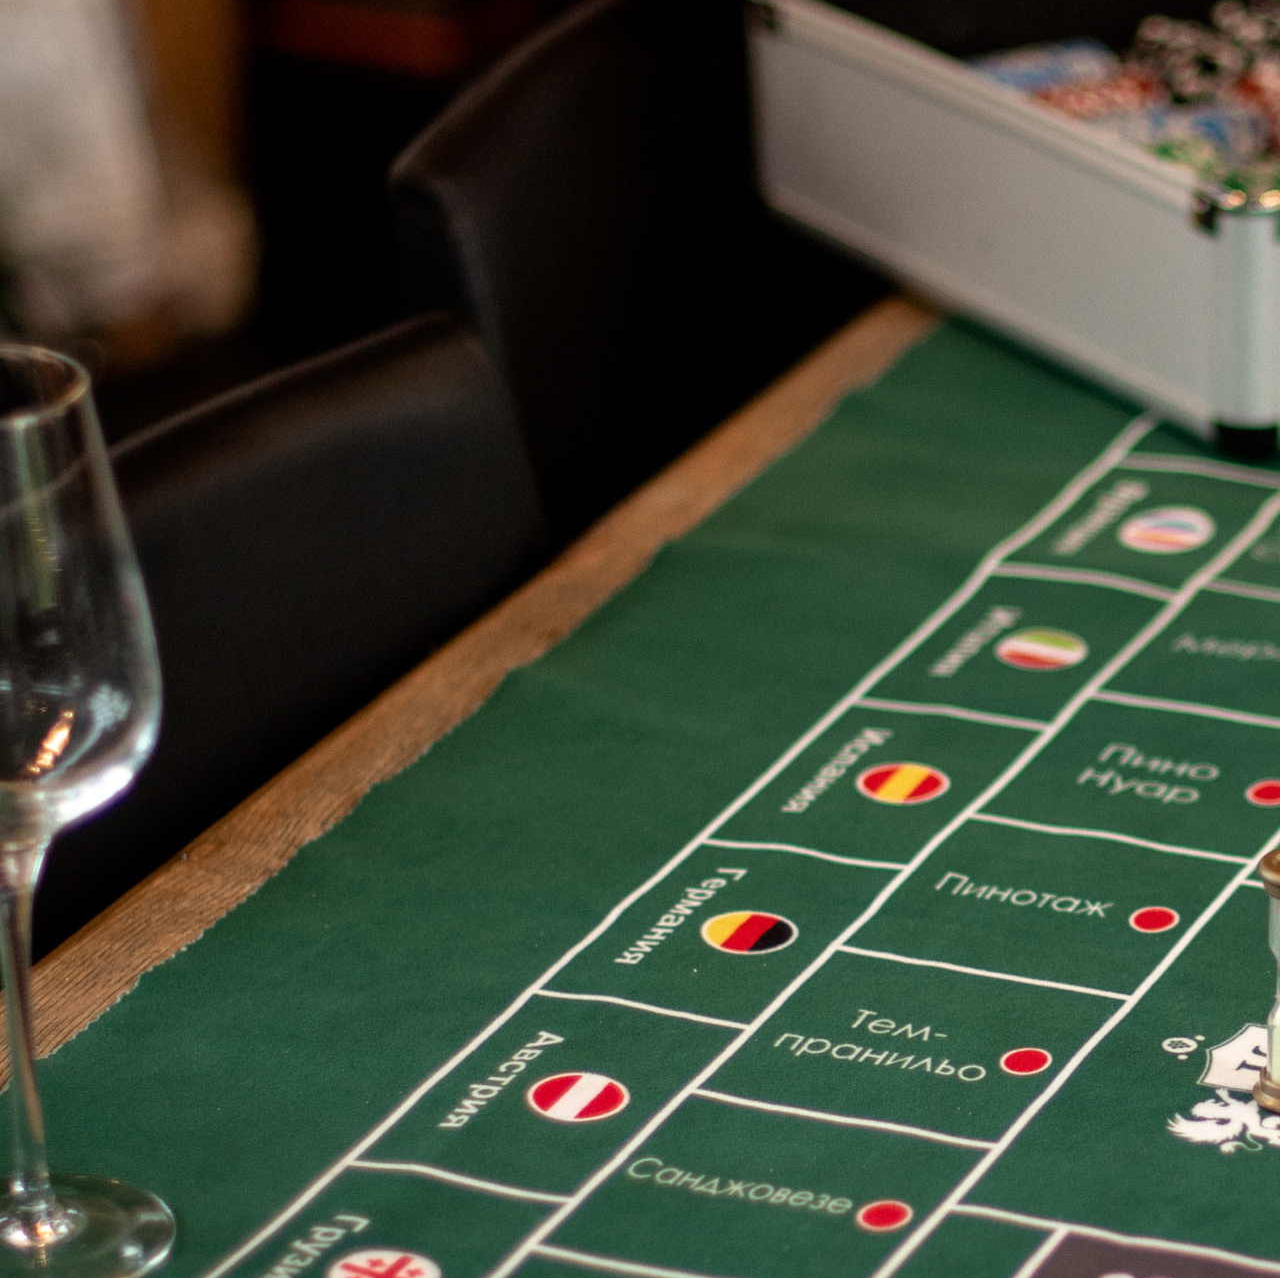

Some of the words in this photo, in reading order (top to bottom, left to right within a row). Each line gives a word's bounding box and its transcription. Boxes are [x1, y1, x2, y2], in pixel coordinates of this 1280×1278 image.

[781, 725, 896, 815] Испания
[1075, 766, 1202, 808] Нуар
[1096, 741, 1220, 783] Пино
[614, 865, 748, 967] Германия
[933, 870, 1114, 920] Пинотаж
[848, 1007, 949, 1044] Тем-
[439, 1028, 565, 1130] Австрия
[772, 1032, 988, 1083] пранильо
[624, 1156, 854, 1216] Санджовезе
